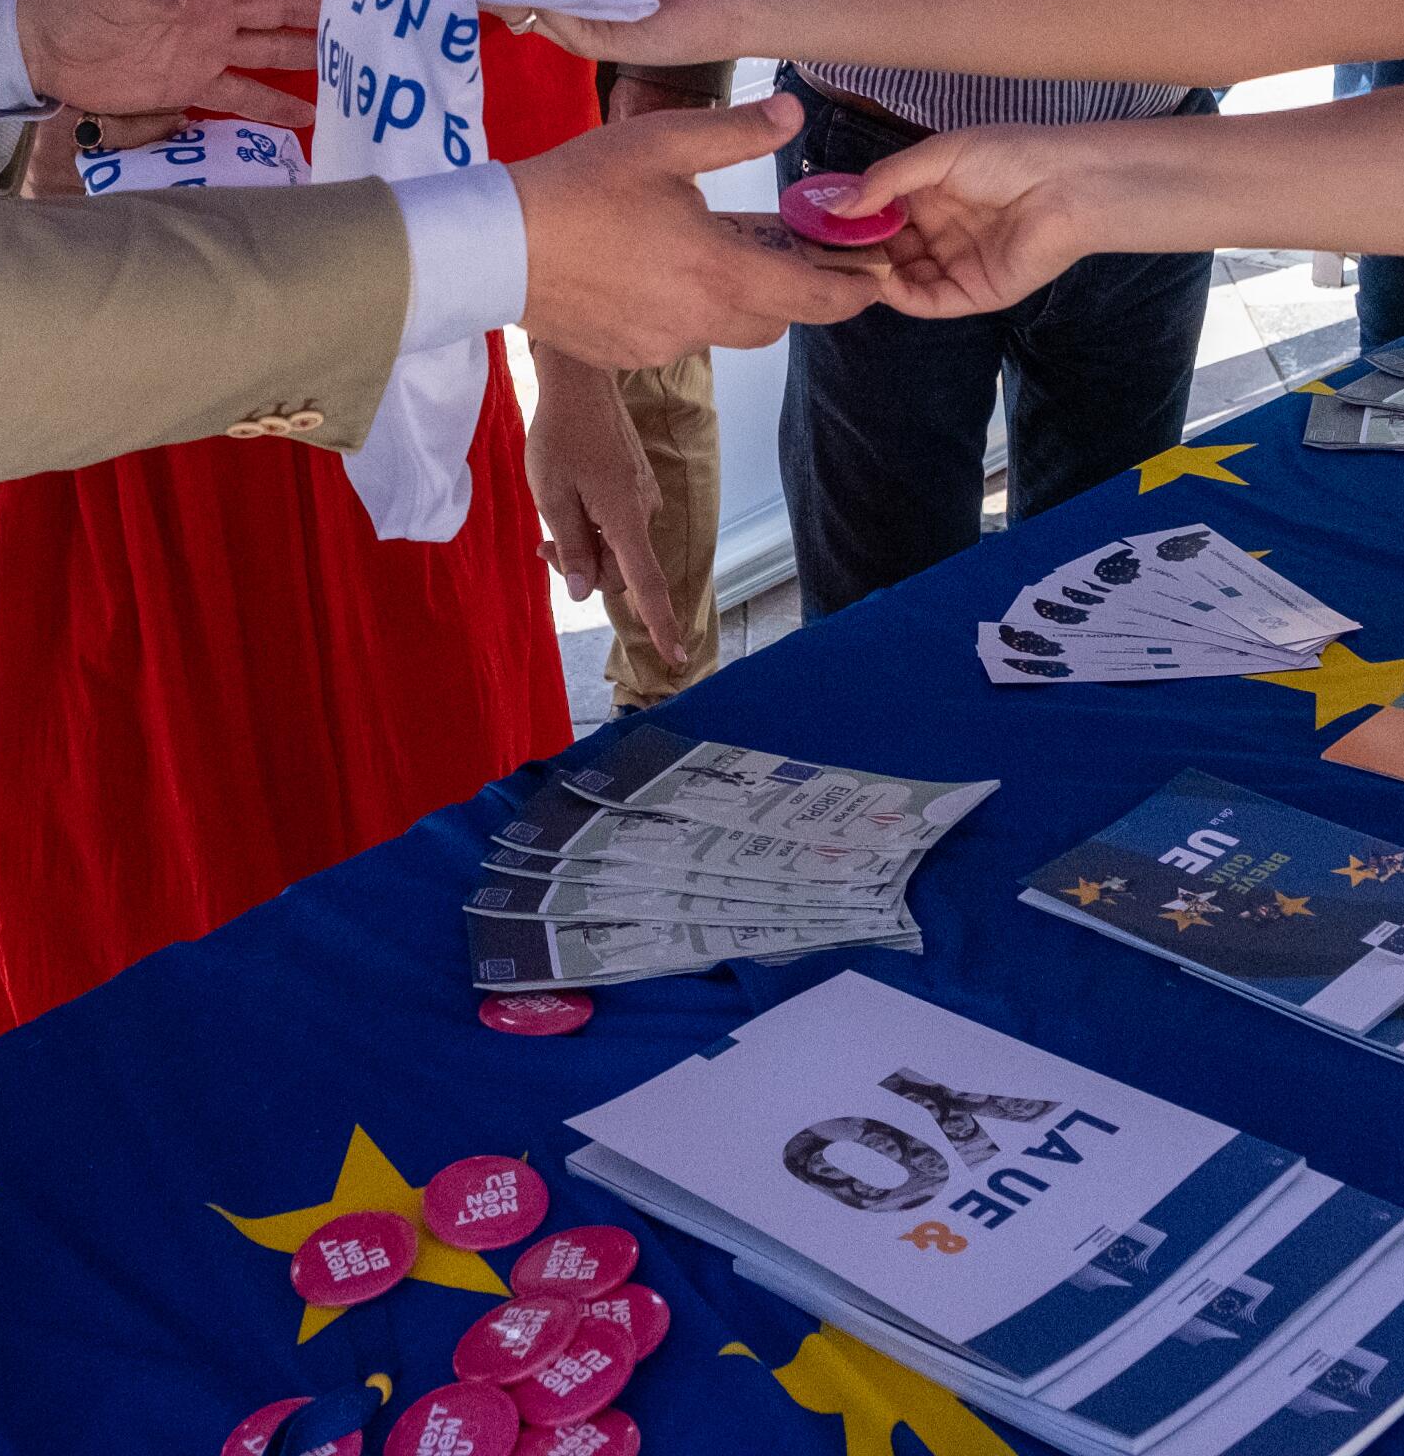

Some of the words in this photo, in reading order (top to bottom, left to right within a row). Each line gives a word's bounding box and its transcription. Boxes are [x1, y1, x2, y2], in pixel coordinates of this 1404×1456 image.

[318, 18, 354, 119] May
[357, 66, 427, 144] de
[444, 111, 472, 167] 9
[795, 785, 853, 822] EUROPA
[1219, 807, 1235, 820] de
[1158, 829, 1241, 875] UE
[1228, 852, 1291, 895] BREVE
[782, 1066, 1063, 1213] YO
[1021, 1109, 1120, 1165] LA
[485, 1170, 517, 1189] EU
[948, 1167, 1052, 1230] UE
[898, 1220, 969, 1255] &
[365, 1247, 392, 1273] EU
[577, 1258, 599, 1281] EU
[580, 1348, 613, 1373] EU
